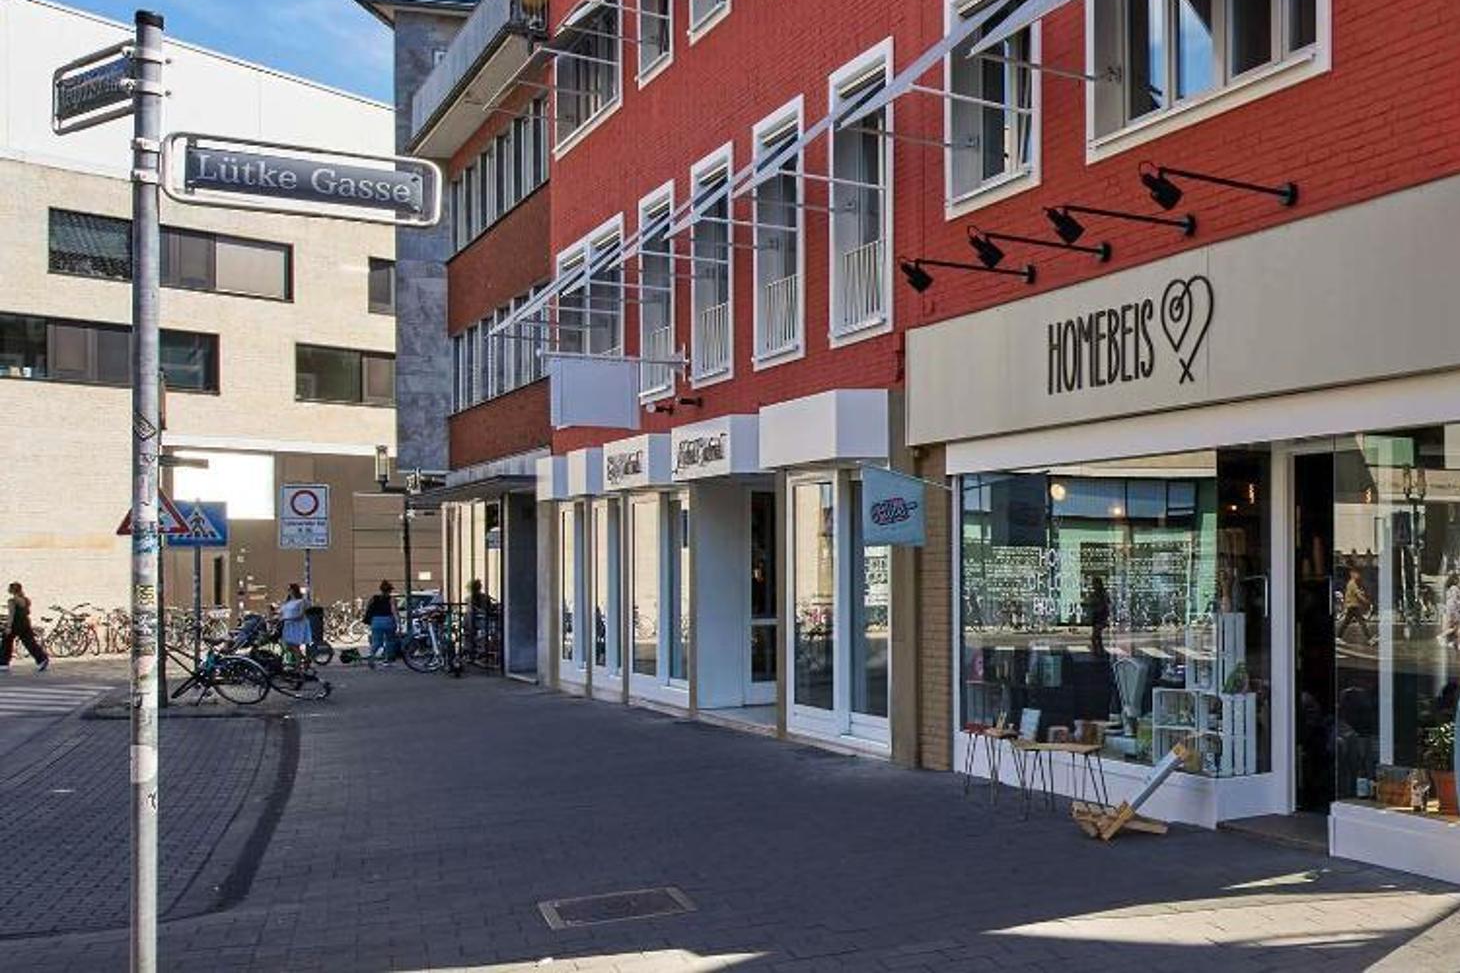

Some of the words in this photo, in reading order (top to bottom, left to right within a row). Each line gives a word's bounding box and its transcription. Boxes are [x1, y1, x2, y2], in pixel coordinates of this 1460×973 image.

[197, 154, 297, 190] Lütke
[311, 168, 411, 203] Gasse
[1048, 298, 1155, 395] HOMEBEIS
